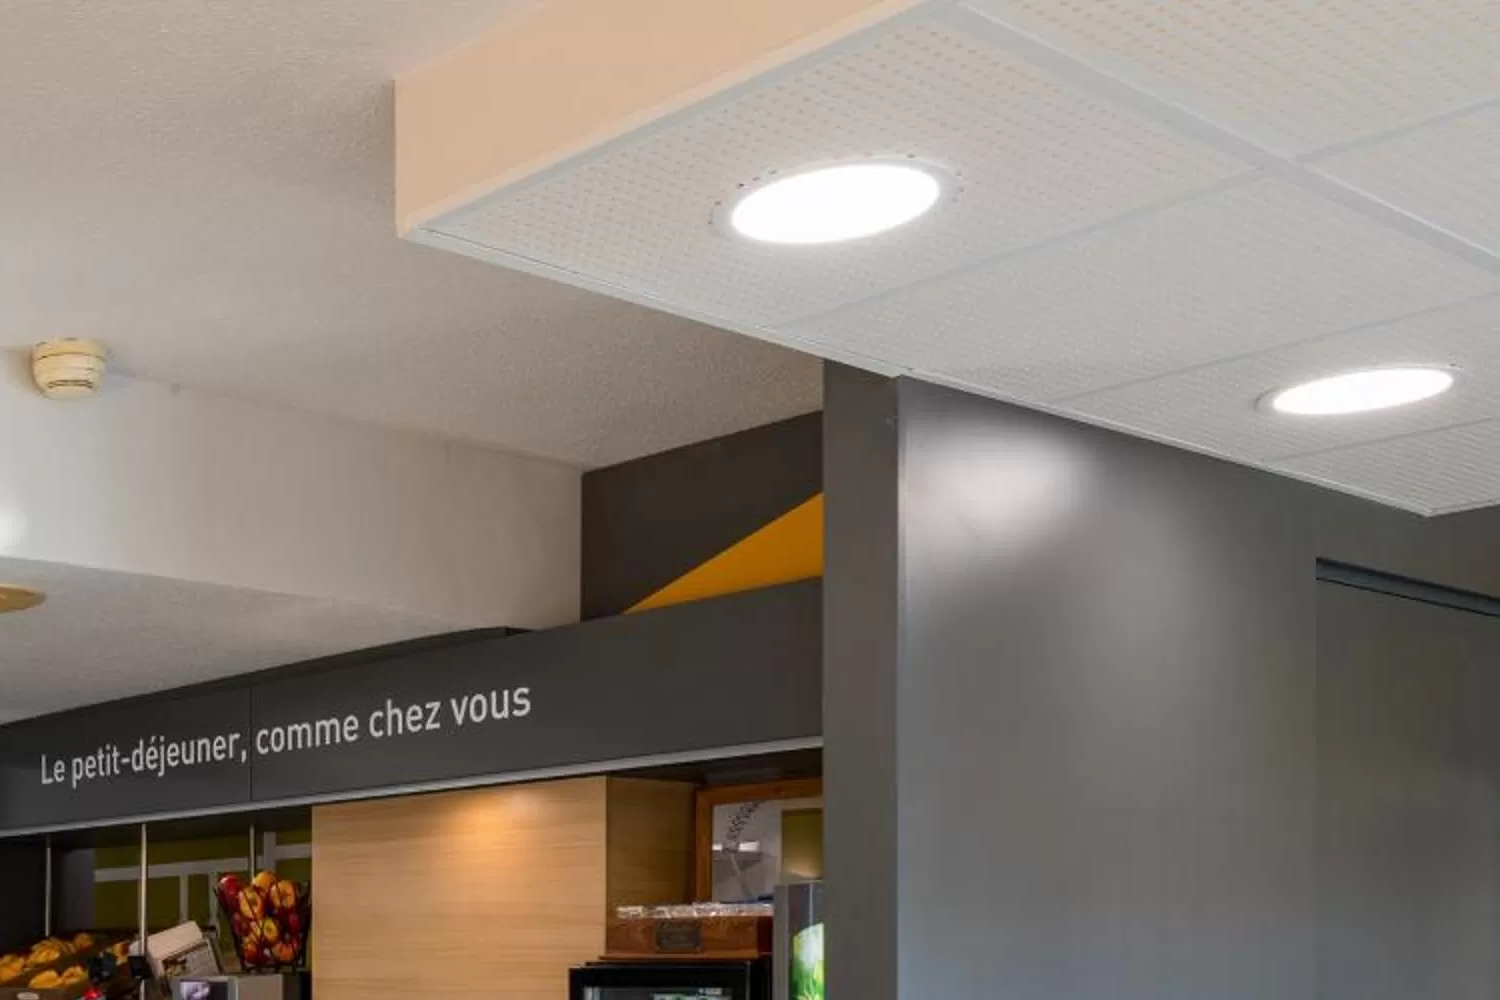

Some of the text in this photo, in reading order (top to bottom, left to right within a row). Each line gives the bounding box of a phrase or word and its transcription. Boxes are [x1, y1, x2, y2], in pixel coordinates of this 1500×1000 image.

[41, 687, 532, 789] Le petit-déjeuner, comme chez vous
